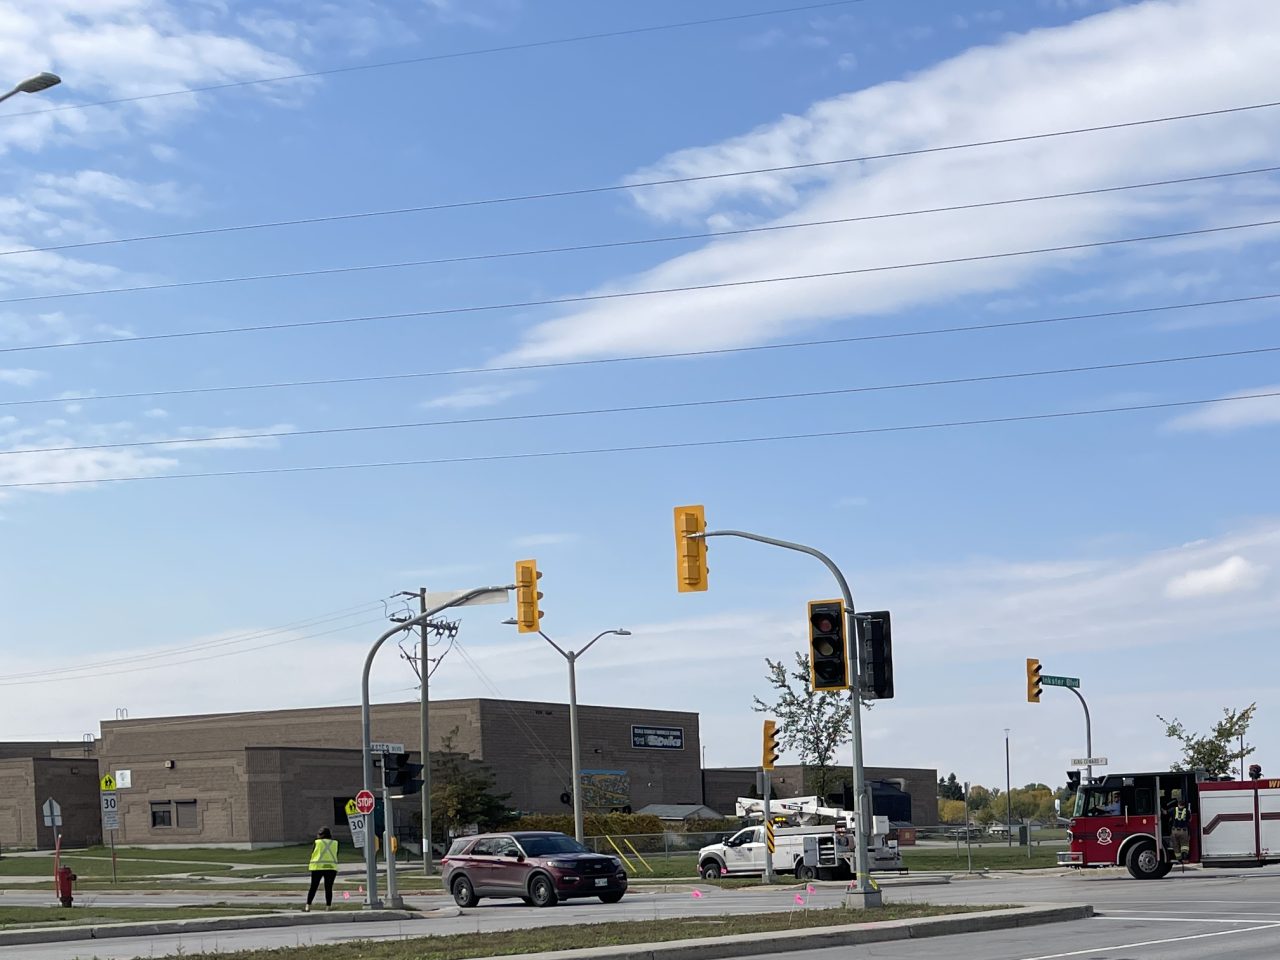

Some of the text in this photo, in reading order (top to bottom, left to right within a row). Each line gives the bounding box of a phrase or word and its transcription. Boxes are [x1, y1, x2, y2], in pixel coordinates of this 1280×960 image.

[1042, 676, 1078, 687] Inkster Blvd
[103, 798, 116, 809] 30
[358, 797, 373, 807] STOP
[351, 819, 364, 830] 30
